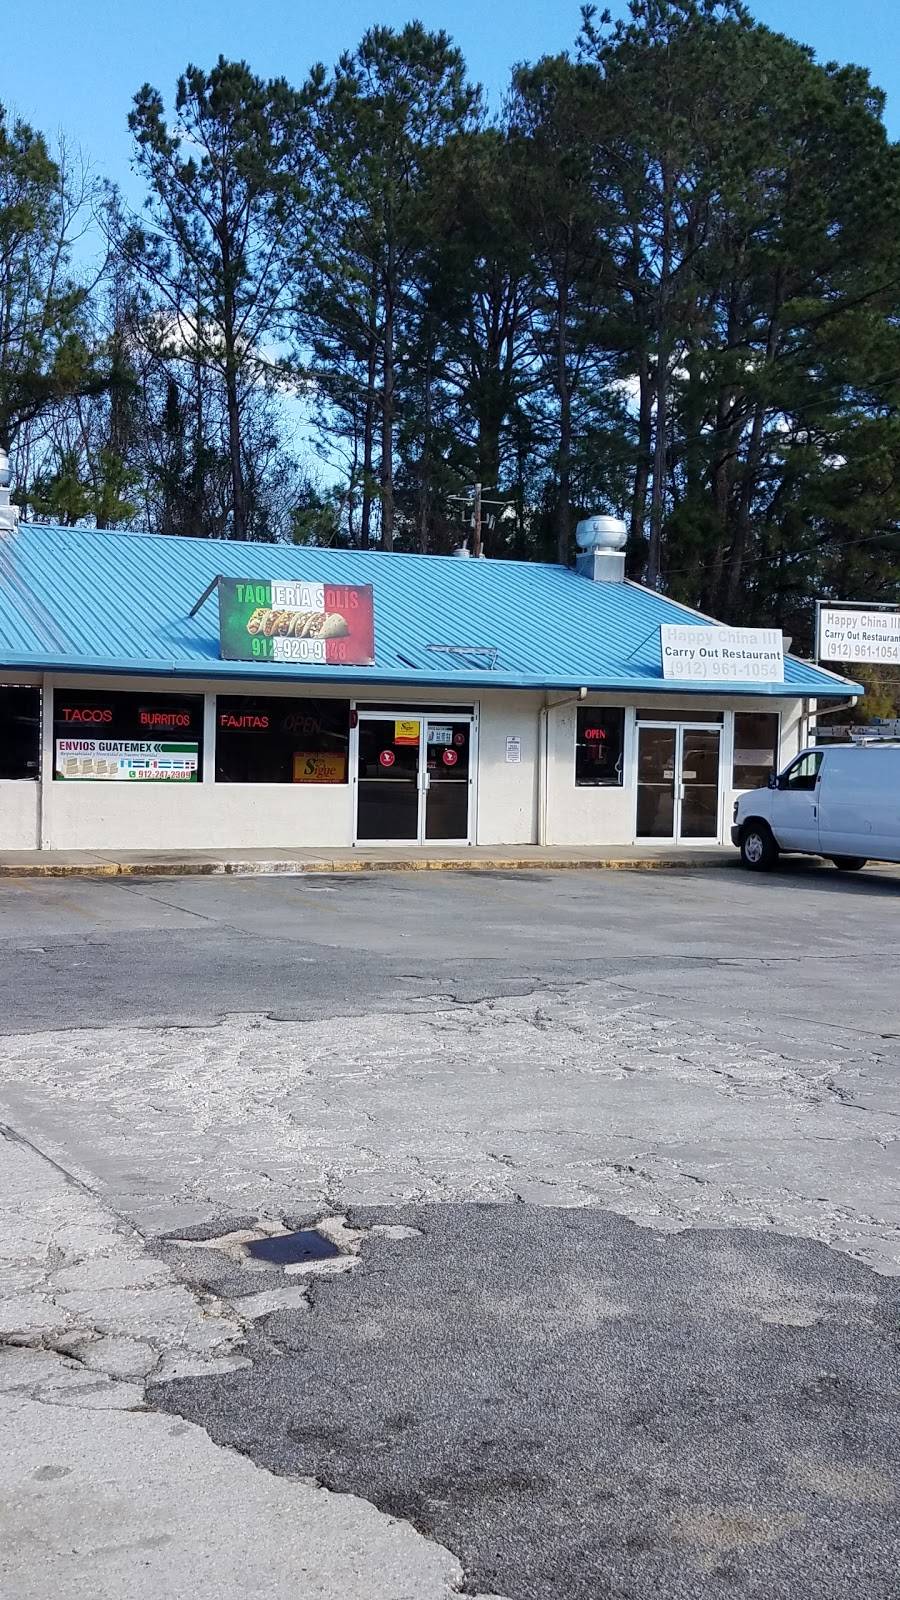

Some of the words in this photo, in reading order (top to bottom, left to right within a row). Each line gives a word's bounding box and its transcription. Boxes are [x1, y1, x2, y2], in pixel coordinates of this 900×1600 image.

[827, 613, 858, 629] Happy
[861, 616, 887, 628] China
[667, 629, 713, 646] Happy
[719, 630, 758, 644] China
[762, 631, 777, 644] III
[825, 629, 845, 641] Carry
[847, 631, 860, 640] Out
[862, 632, 900, 642] Restaurant
[665, 646, 695, 659] Carry
[699, 648, 718, 658] Out
[722, 649, 781, 660] Restaurant
[827, 642, 851, 659] (912)
[854, 645, 898, 658] 961-1054
[671, 661, 707, 678] (912)
[712, 662, 778, 677] 961-1054
[63, 709, 113, 722] TACOS
[140, 713, 190, 726] BURRITOS
[220, 715, 269, 728] FAJITAS
[285, 712, 321, 734] OPEN
[585, 729, 606, 739] OPEN
[59, 741, 95, 751] ENVIOS
[99, 742, 151, 753] GUATEMEX
[138, 770, 191, 779] 912-247-2309
[304, 758, 336, 778] Sigue
